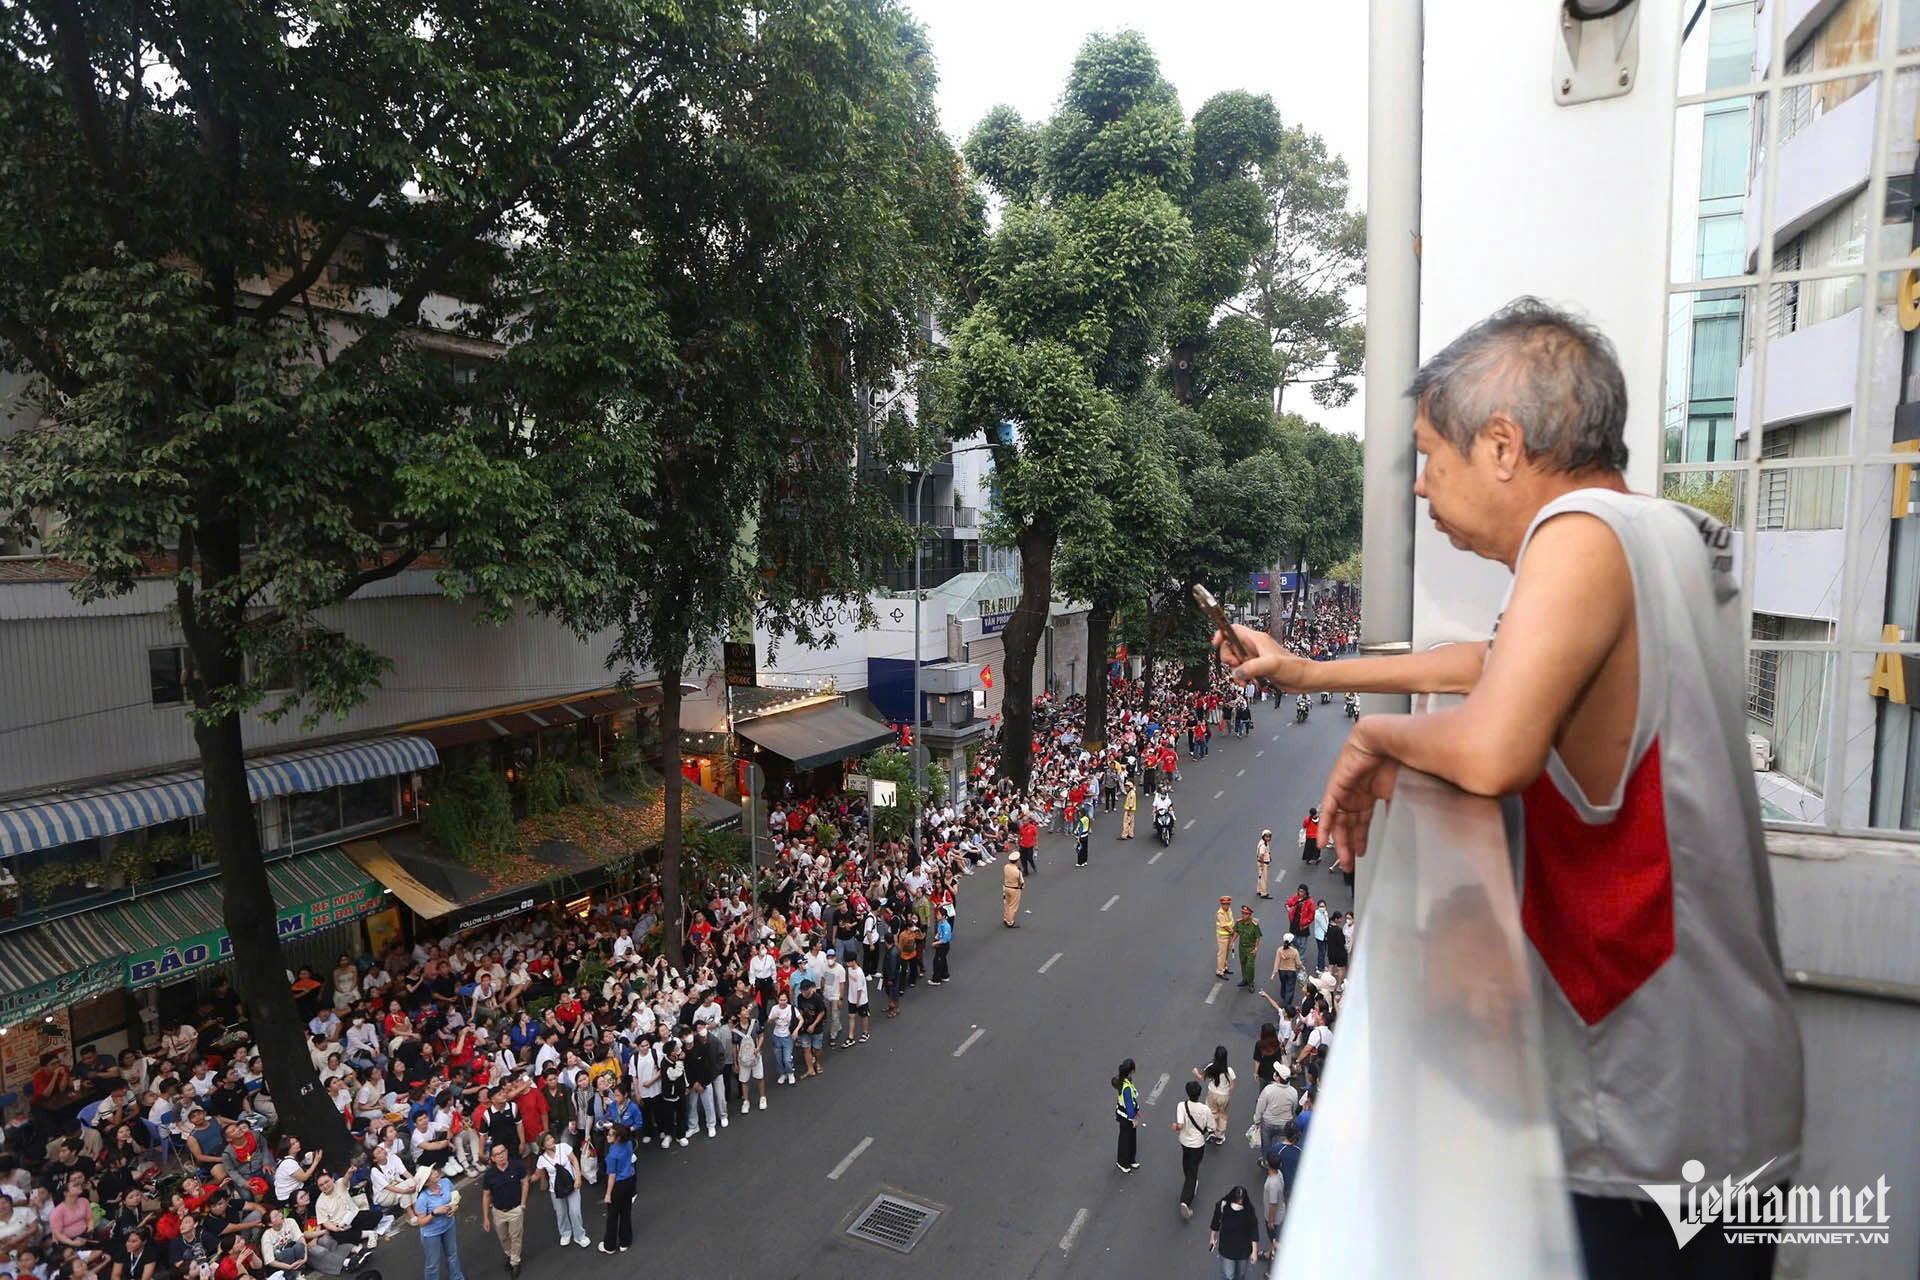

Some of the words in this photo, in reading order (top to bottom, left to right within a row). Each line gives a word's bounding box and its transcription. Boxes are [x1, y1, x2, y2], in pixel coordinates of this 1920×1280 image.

[311, 899, 330, 914] XE
[312, 914, 331, 928] XE
[130, 945, 208, 984] BẢO
